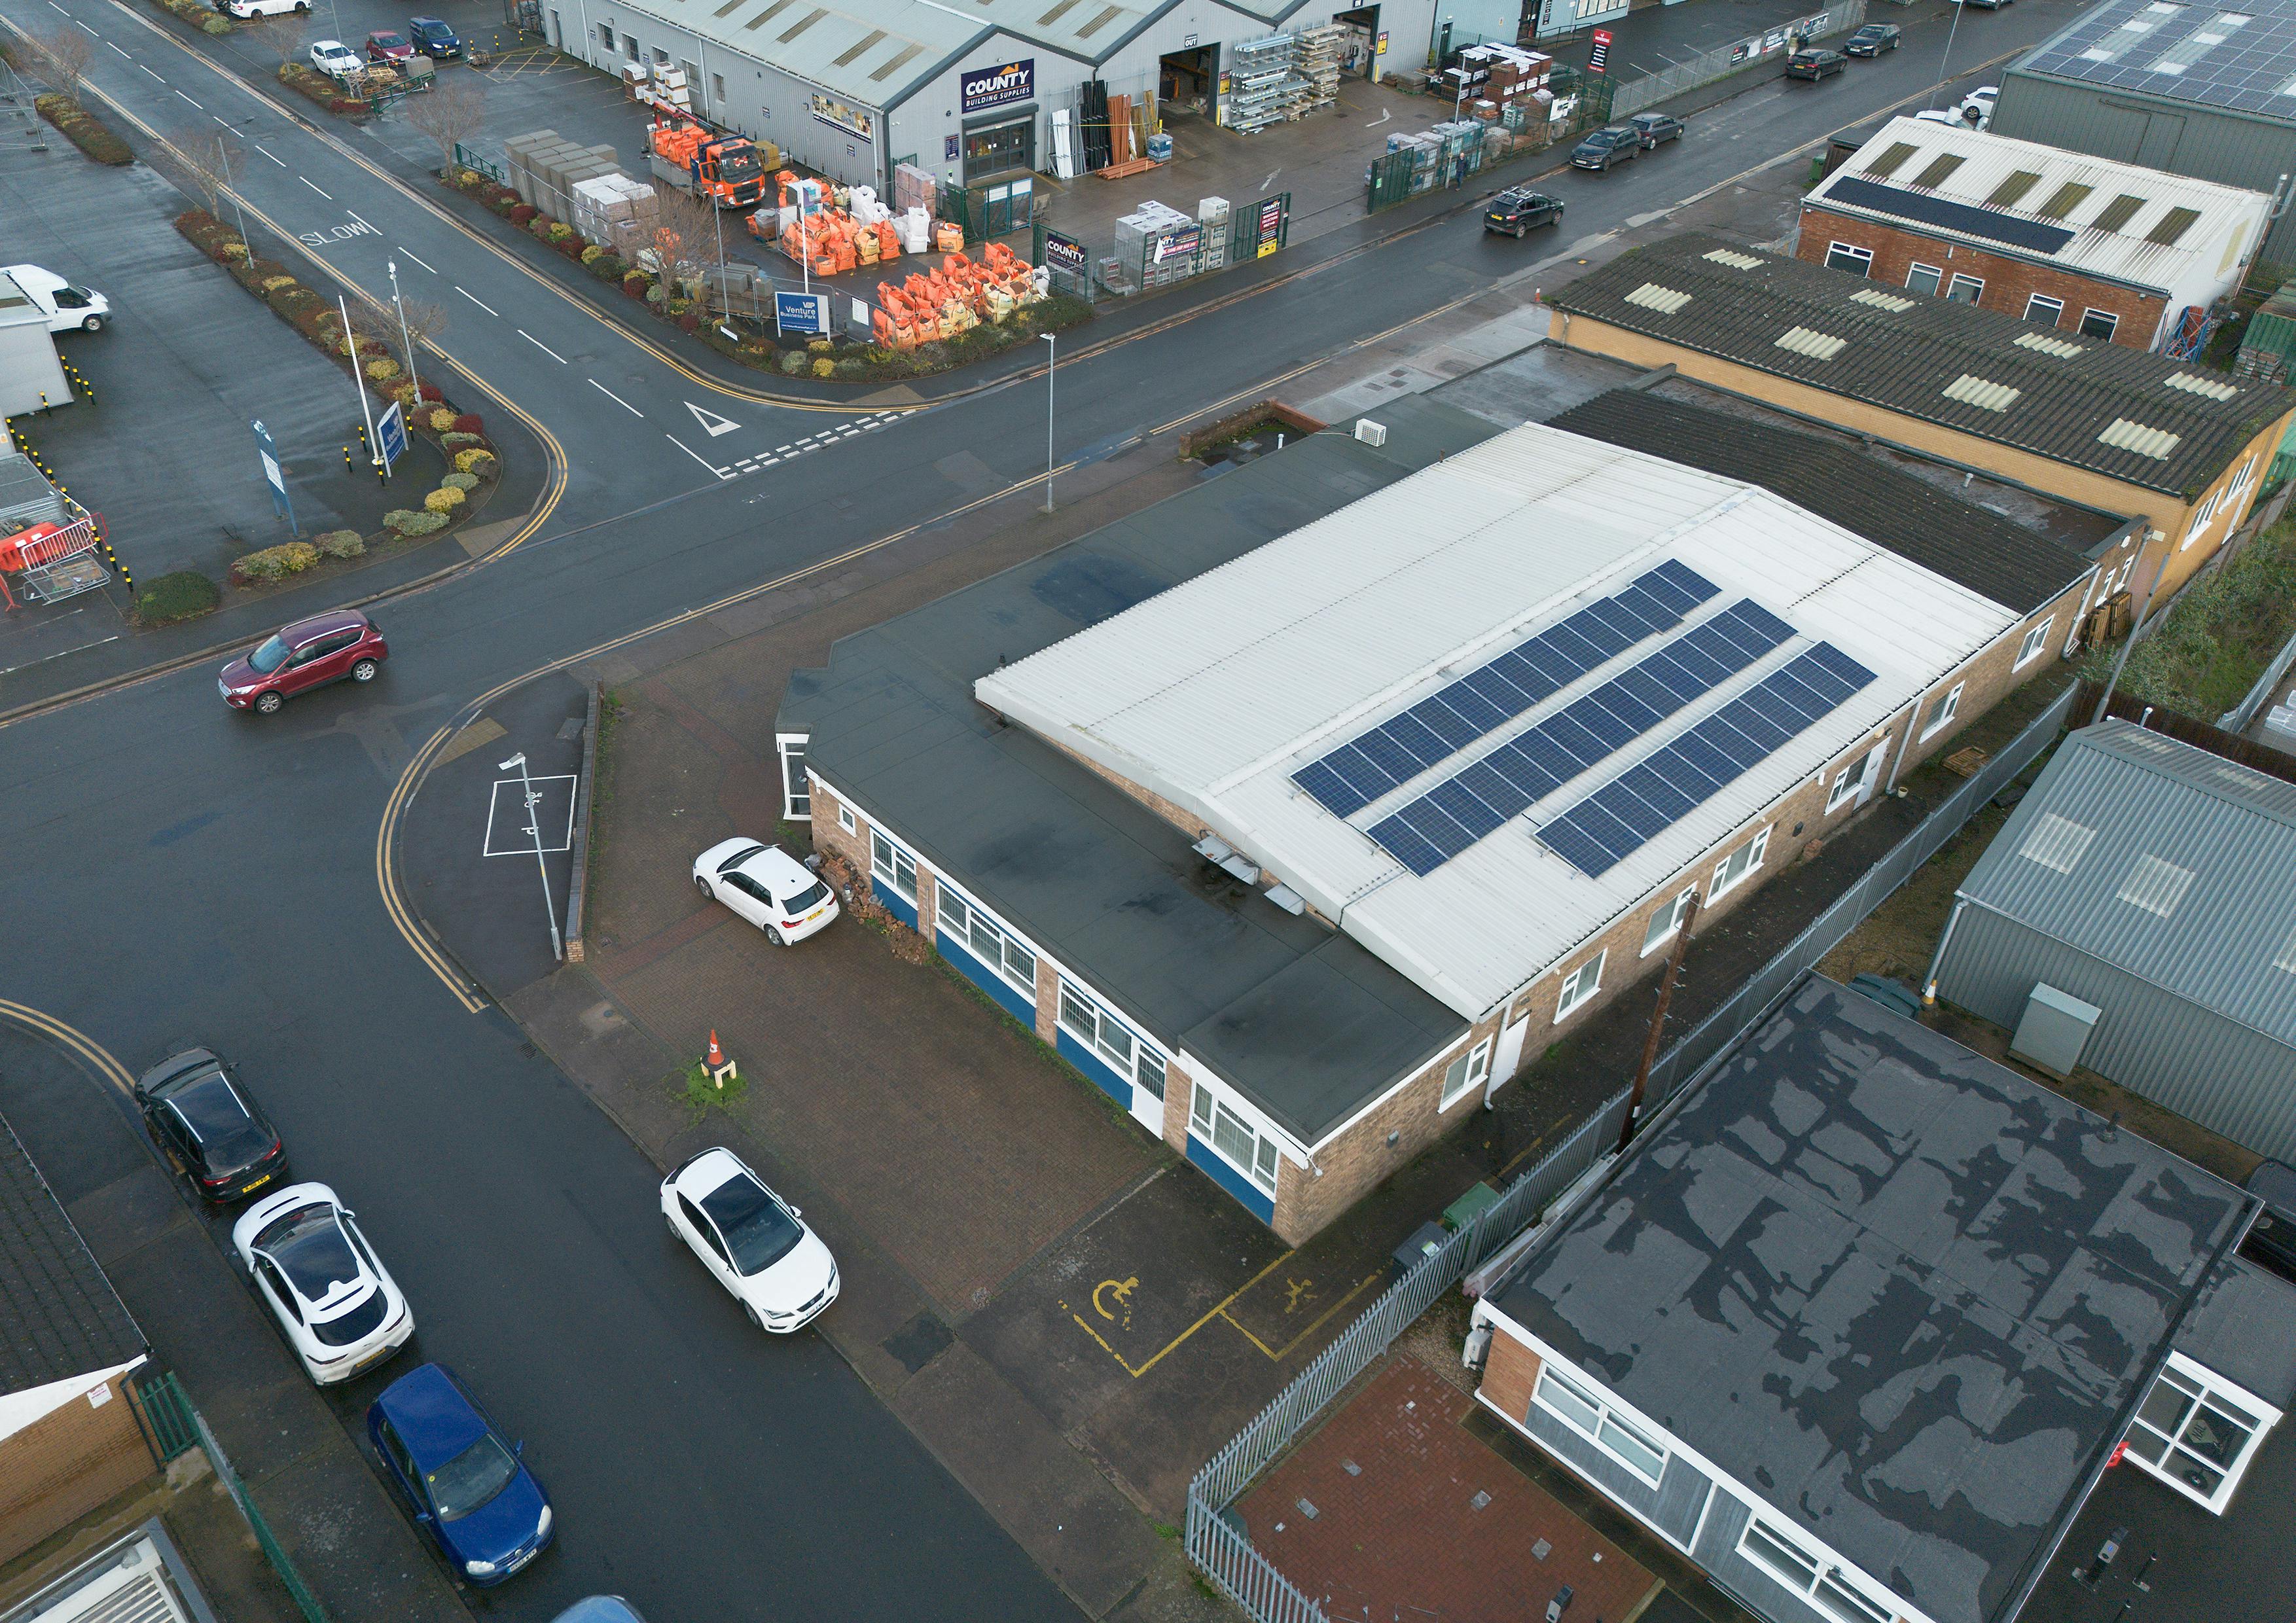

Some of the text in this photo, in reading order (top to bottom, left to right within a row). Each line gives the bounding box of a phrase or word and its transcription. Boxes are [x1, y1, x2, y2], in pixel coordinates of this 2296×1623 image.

[1185, 38, 1197, 46] OUT
[965, 69, 1030, 96] COUNTY
[966, 94, 998, 107] BUILDING
[1000, 86, 1030, 100] SUPPLIES
[1263, 201, 1280, 212] COUNTY
[298, 222, 369, 246] SLOW
[1048, 240, 1085, 262] COUNTY
[785, 306, 816, 315] Venture
